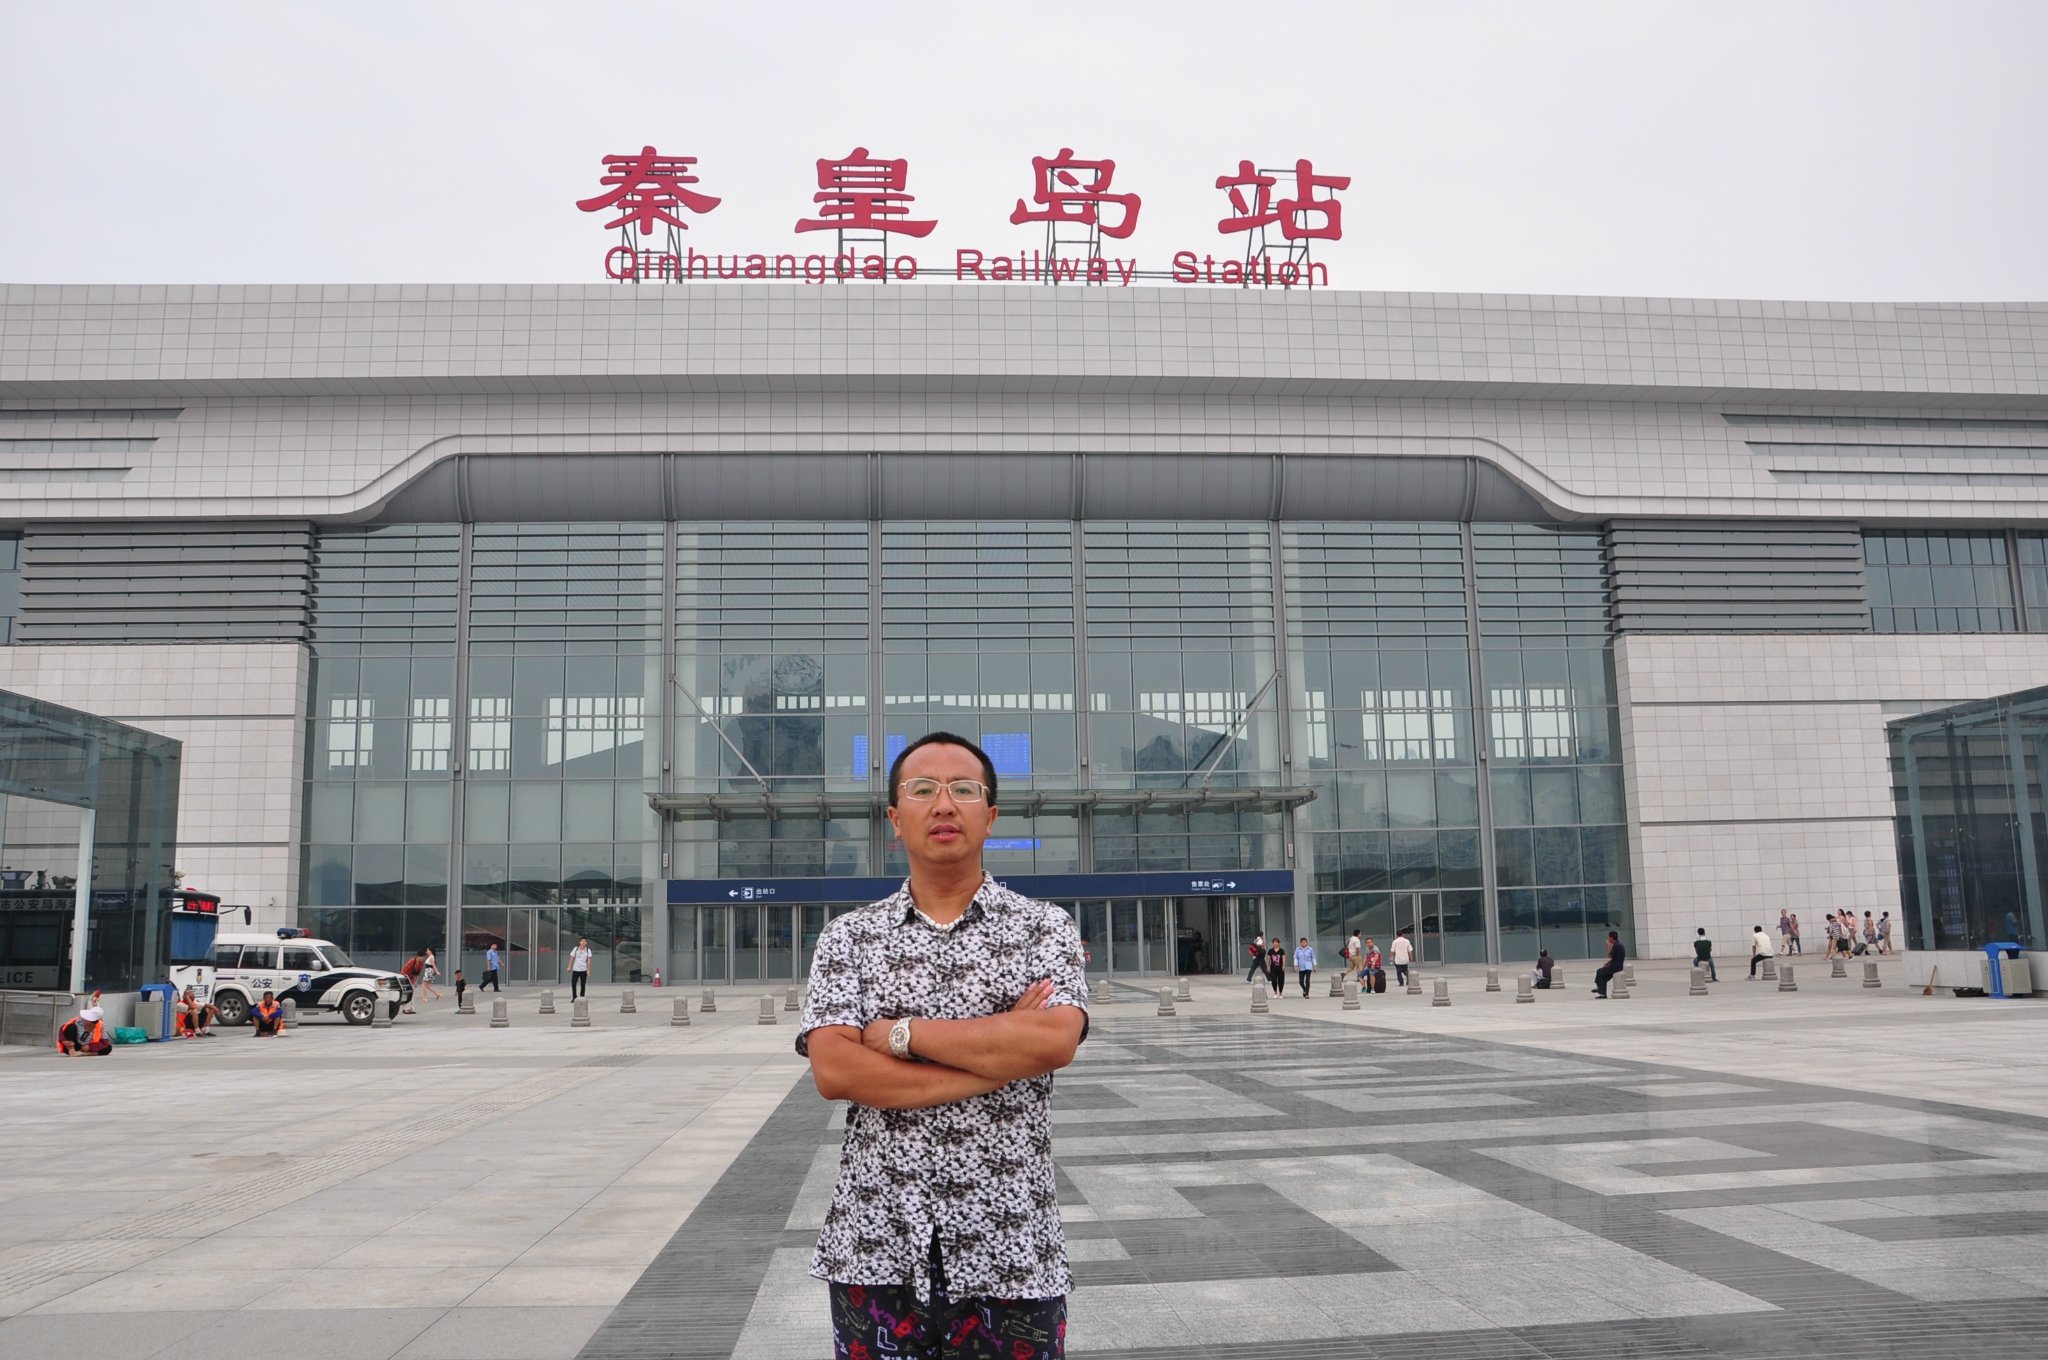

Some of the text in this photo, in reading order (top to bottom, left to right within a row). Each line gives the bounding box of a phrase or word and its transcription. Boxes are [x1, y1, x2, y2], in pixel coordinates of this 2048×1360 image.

[576, 146, 1351, 240] 秦皇岛站
[605, 246, 1328, 287] Qinhuangdao Railway Station
[251, 977, 273, 989] 公安
